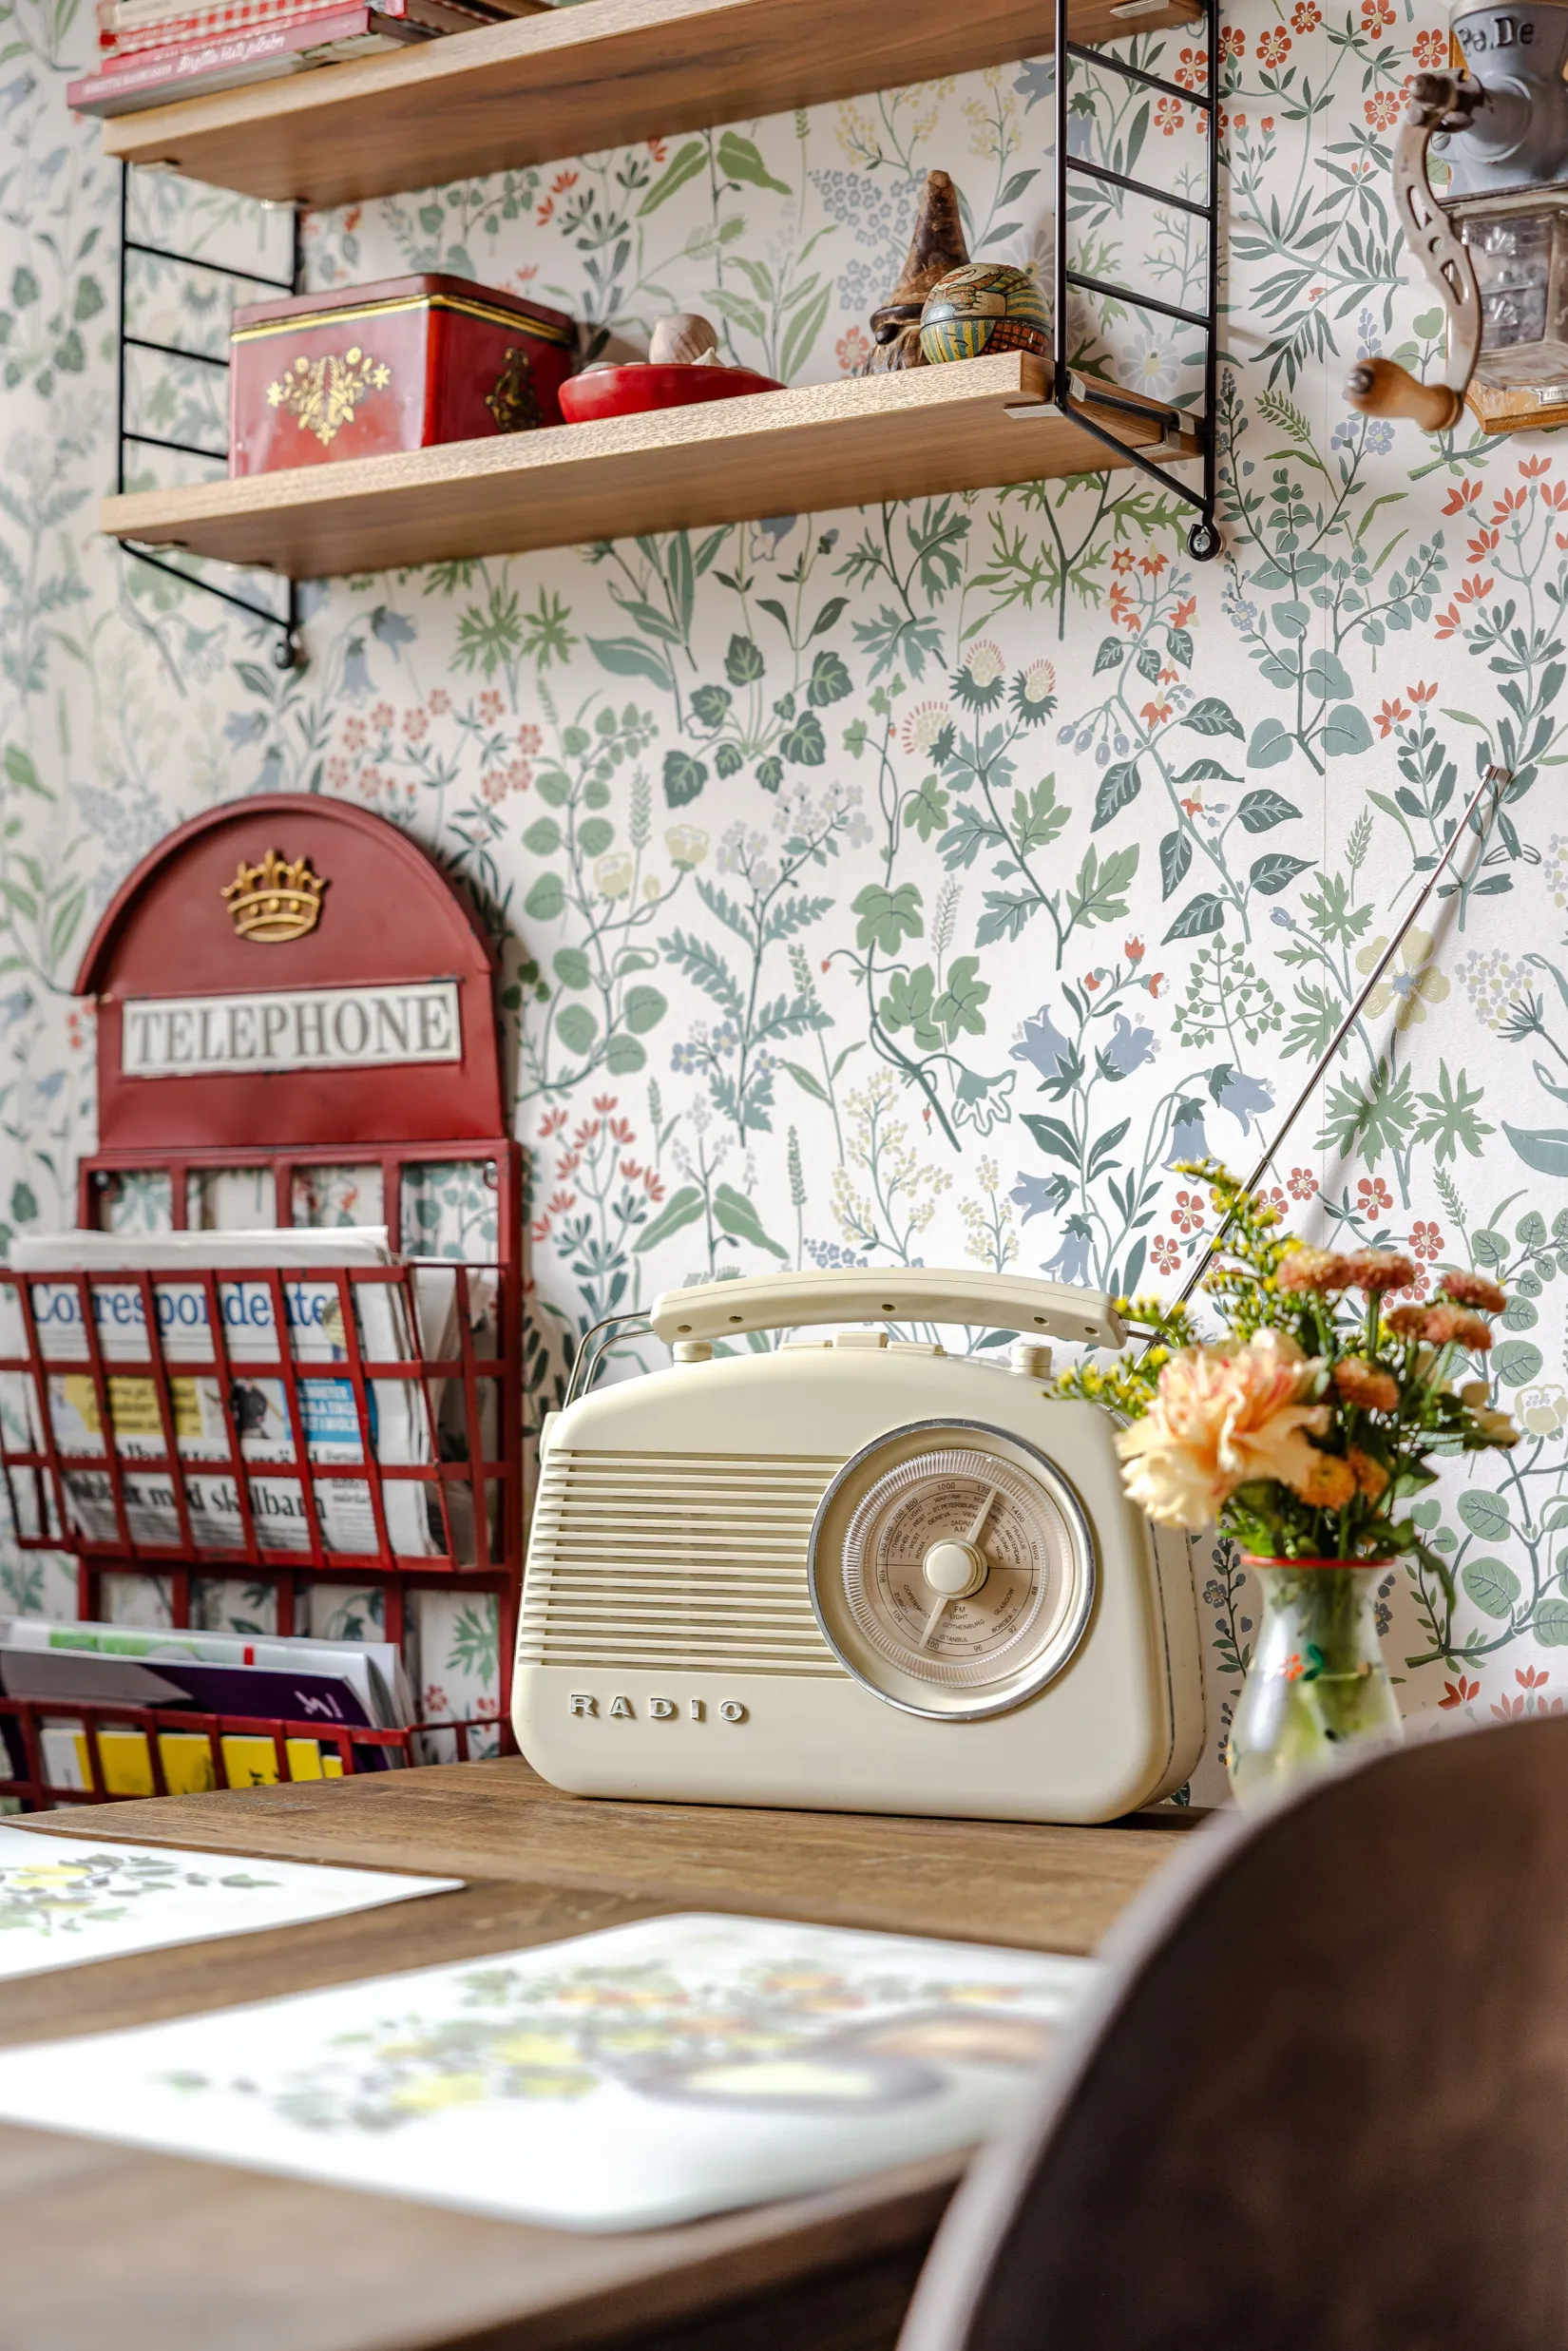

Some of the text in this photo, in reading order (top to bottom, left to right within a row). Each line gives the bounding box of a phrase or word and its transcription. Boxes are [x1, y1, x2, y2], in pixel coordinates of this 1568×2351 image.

[131, 995, 450, 1064] TELEPHONE
[937, 1481, 956, 1491] 1000
[977, 1485, 990, 1494] 120
[906, 1498, 918, 1510] 800
[892, 1508, 905, 1522] 700
[1011, 1506, 1025, 1523] 1400
[884, 1526, 893, 1541] 600
[893, 1531, 903, 1548] THIRD
[908, 1505, 924, 1520] LIGHT
[1012, 1525, 1026, 1550] PRAGUE
[909, 1533, 920, 1549] WEST
[927, 1512, 950, 1525] GENEVA
[992, 1527, 1010, 1553] HELSINKI
[912, 1514, 927, 1527] WEST
[1004, 1530, 1021, 1564] AMSTERDAM
[915, 1541, 926, 1559] ROMA
[995, 1546, 1004, 1560] NICE
[892, 1610, 903, 1622] 104
[894, 1593, 908, 1614] ZURICH
[991, 1608, 1018, 1633] BORDEAUX
[943, 1619, 985, 1630] GOTHENBURG
[994, 1588, 1014, 1615] GLASGOW
[927, 1639, 939, 1650] 100
[570, 1693, 745, 1722] RADIO
